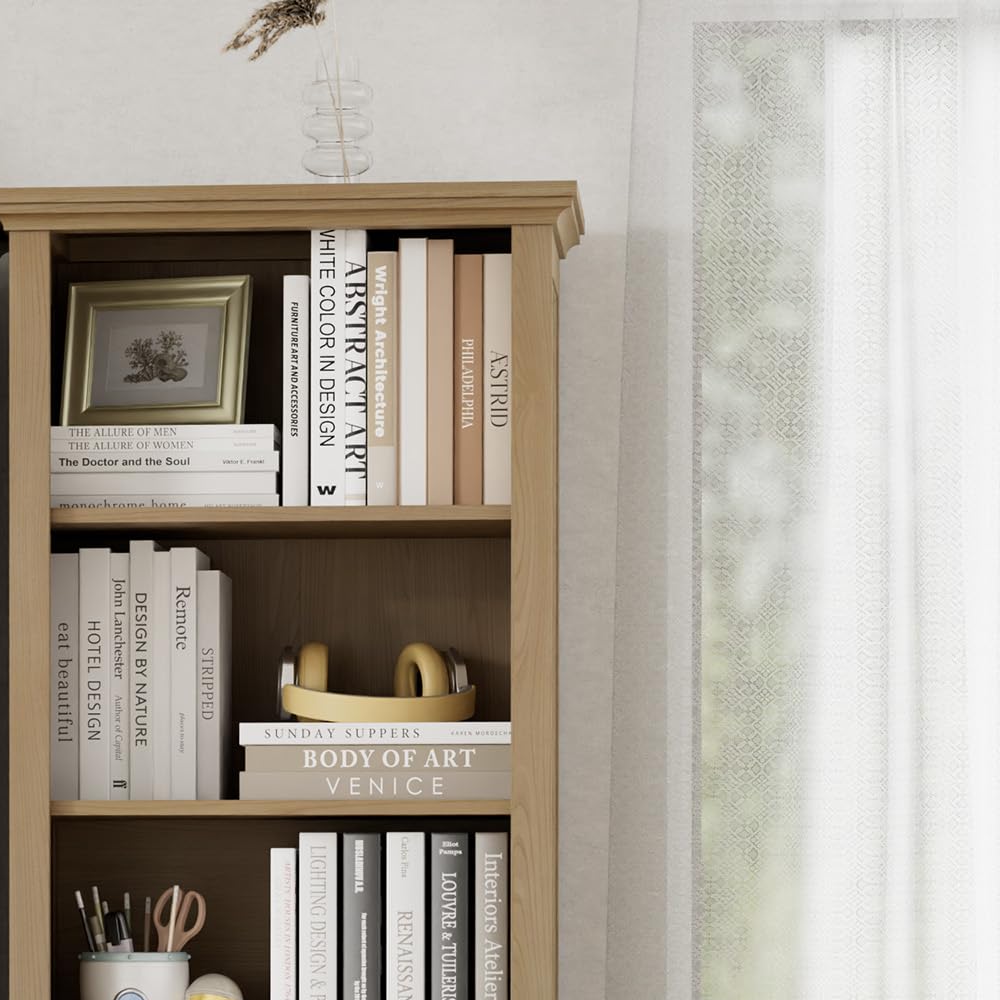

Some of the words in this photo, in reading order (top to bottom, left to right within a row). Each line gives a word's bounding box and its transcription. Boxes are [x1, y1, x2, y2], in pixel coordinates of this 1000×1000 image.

[319, 285, 335, 350] COLOR
[372, 265, 388, 325] Wright
[290, 302, 298, 348] FURNITURE
[345, 261, 367, 414] ABSTRACT
[290, 348, 298, 364] ART
[290, 365, 298, 383] AND
[319, 355, 335, 372] IN
[290, 384, 298, 437] ACCESSORIES
[375, 330, 388, 439] Architecture
[462, 338, 474, 429] PHILADELPHIA
[68, 428, 91, 437] THE
[93, 427, 134, 437] ALLURE
[137, 427, 151, 436] OF
[153, 427, 177, 436] MEN
[319, 378, 335, 447] DESIGN
[59, 457, 79, 467] The
[82, 457, 118, 466] Doctor
[122, 457, 142, 466] and
[145, 457, 163, 466] the
[165, 456, 190, 466] Soul
[68, 442, 90, 450] THE
[92, 441, 133, 450] ALLURE
[136, 441, 151, 449] OF
[153, 440, 194, 449] WOMEN
[345, 423, 367, 480] ART
[112, 578, 126, 608] John
[176, 586, 191, 651] Remote
[58, 623, 71, 650] eat
[88, 621, 101, 674] HOTEL
[114, 612, 126, 679] Lanchester
[135, 593, 147, 652] DESIGN
[135, 659, 147, 678] BY
[201, 647, 214, 721] STRIPPED
[58, 658, 73, 742] beautiful
[88, 681, 101, 741] DESIGN
[115, 695, 123, 724] Author
[135, 683, 147, 747] NATURE
[264, 728, 336, 739] SUNDAY
[345, 728, 420, 739] SUPPERS
[303, 749, 375, 768] BODY
[382, 749, 417, 767] OF
[424, 749, 476, 767] ART
[325, 777, 444, 795] VENICE
[310, 846, 326, 916] LIGHTING
[441, 873, 457, 929] LOUVRE
[484, 853, 503, 933] Interiors
[310, 920, 326, 974] DESIGN
[441, 932, 452, 941] &
[310, 979, 326, 989] &
[484, 939, 503, 1000] Atelier
